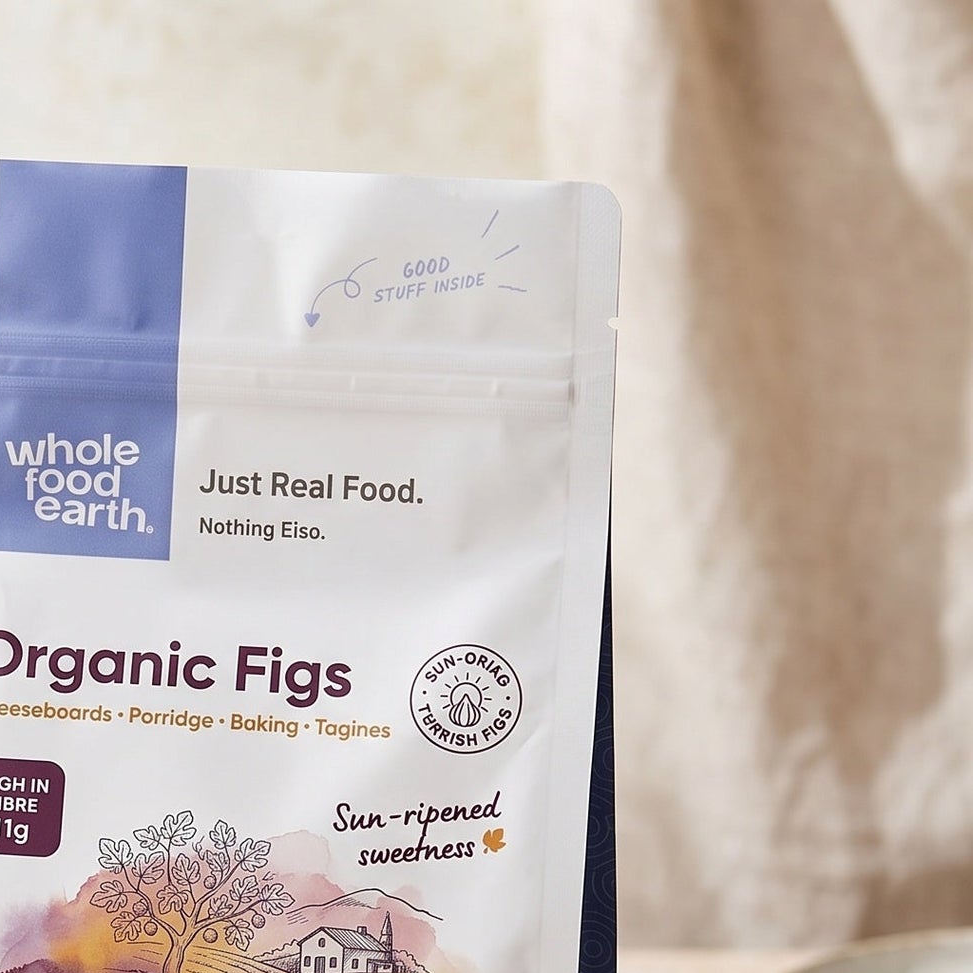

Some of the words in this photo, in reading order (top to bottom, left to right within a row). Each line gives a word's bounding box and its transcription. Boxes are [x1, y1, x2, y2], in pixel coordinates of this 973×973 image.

[403, 256, 450, 279] GOOD
[373, 282, 426, 303] STUFF
[434, 272, 486, 294] INSIDE
[5, 432, 140, 466] whole
[25, 465, 121, 501] food
[199, 469, 262, 496] Just
[271, 472, 333, 499] Real
[343, 475, 423, 504] Food.
[199, 517, 275, 542] Nothing
[234, 645, 353, 708] Figs
[129, 706, 214, 732] Porridge
[230, 713, 299, 738] Baking
[315, 718, 391, 740] Tagines
[481, 708, 512, 742] FIGS
[30, 778, 50, 794] IN
[333, 791, 502, 837] Sun-ripened
[358, 835, 476, 866] sweetness
